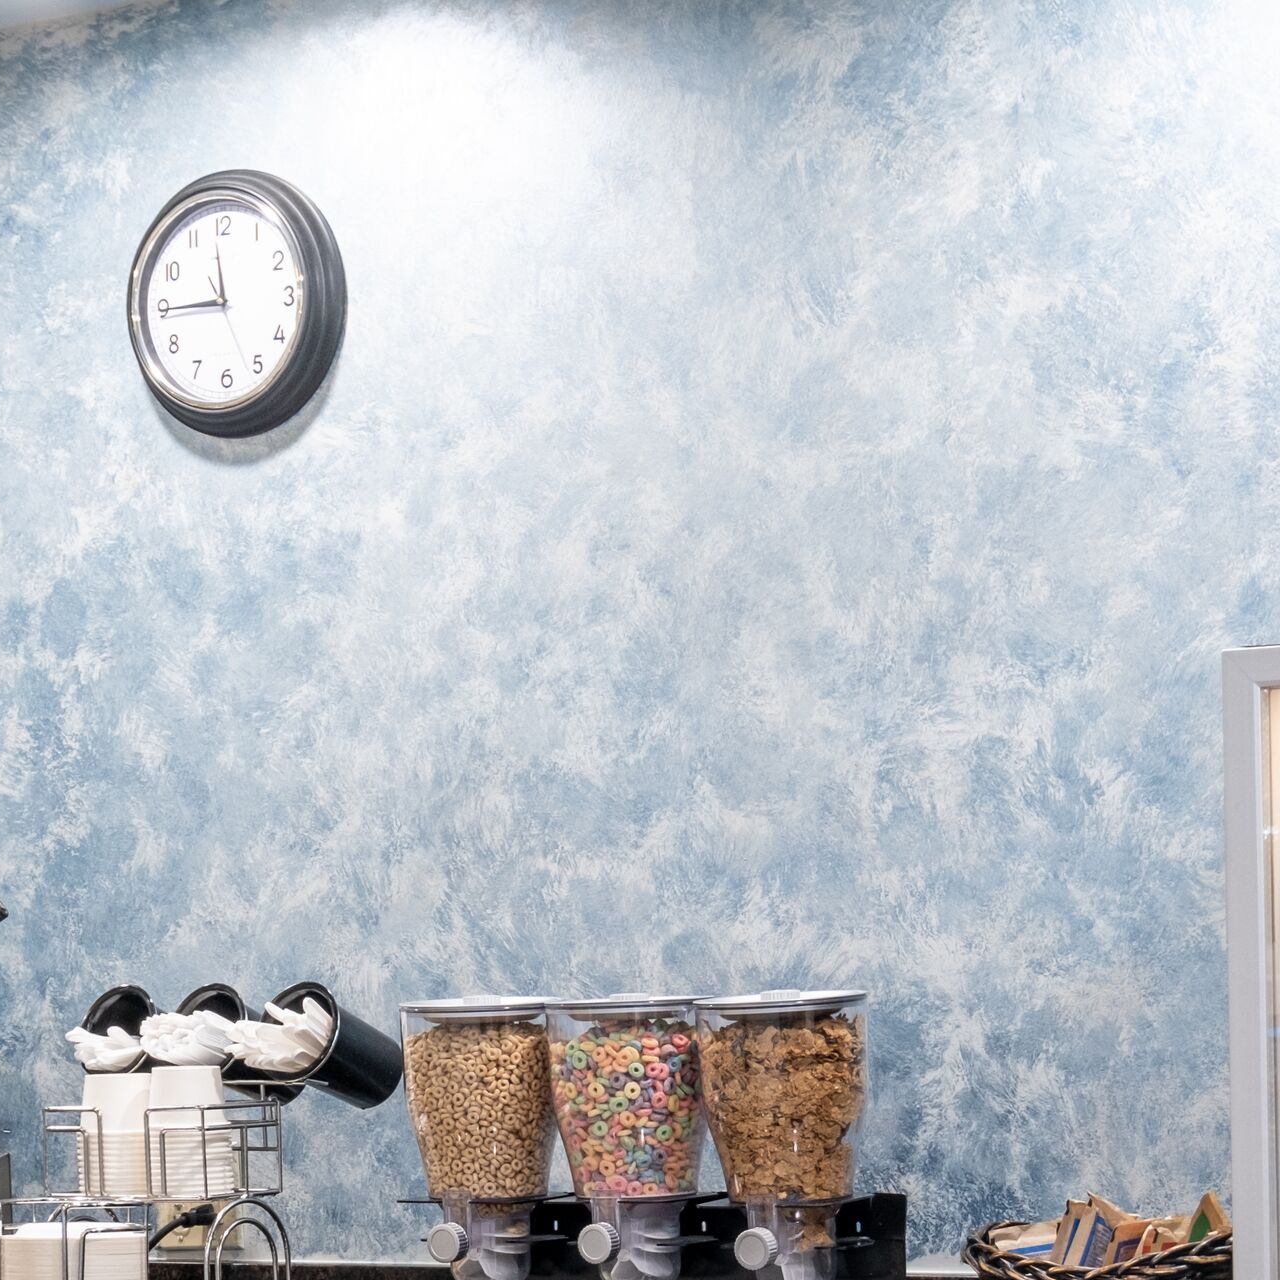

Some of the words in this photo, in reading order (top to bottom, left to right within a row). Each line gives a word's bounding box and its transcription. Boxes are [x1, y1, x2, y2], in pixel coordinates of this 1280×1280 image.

[215, 215, 232, 237] 12
[254, 222, 259, 242] 1
[188, 228, 198, 248] 11
[272, 250, 285, 271] 2
[165, 261, 181, 282] 10
[283, 285, 295, 306] 3
[157, 298, 170, 319] 9
[168, 334, 180, 354] 8
[273, 324, 286, 345] 4
[192, 359, 203, 380] 7
[252, 354, 264, 375] 5
[221, 369, 234, 389] 6
